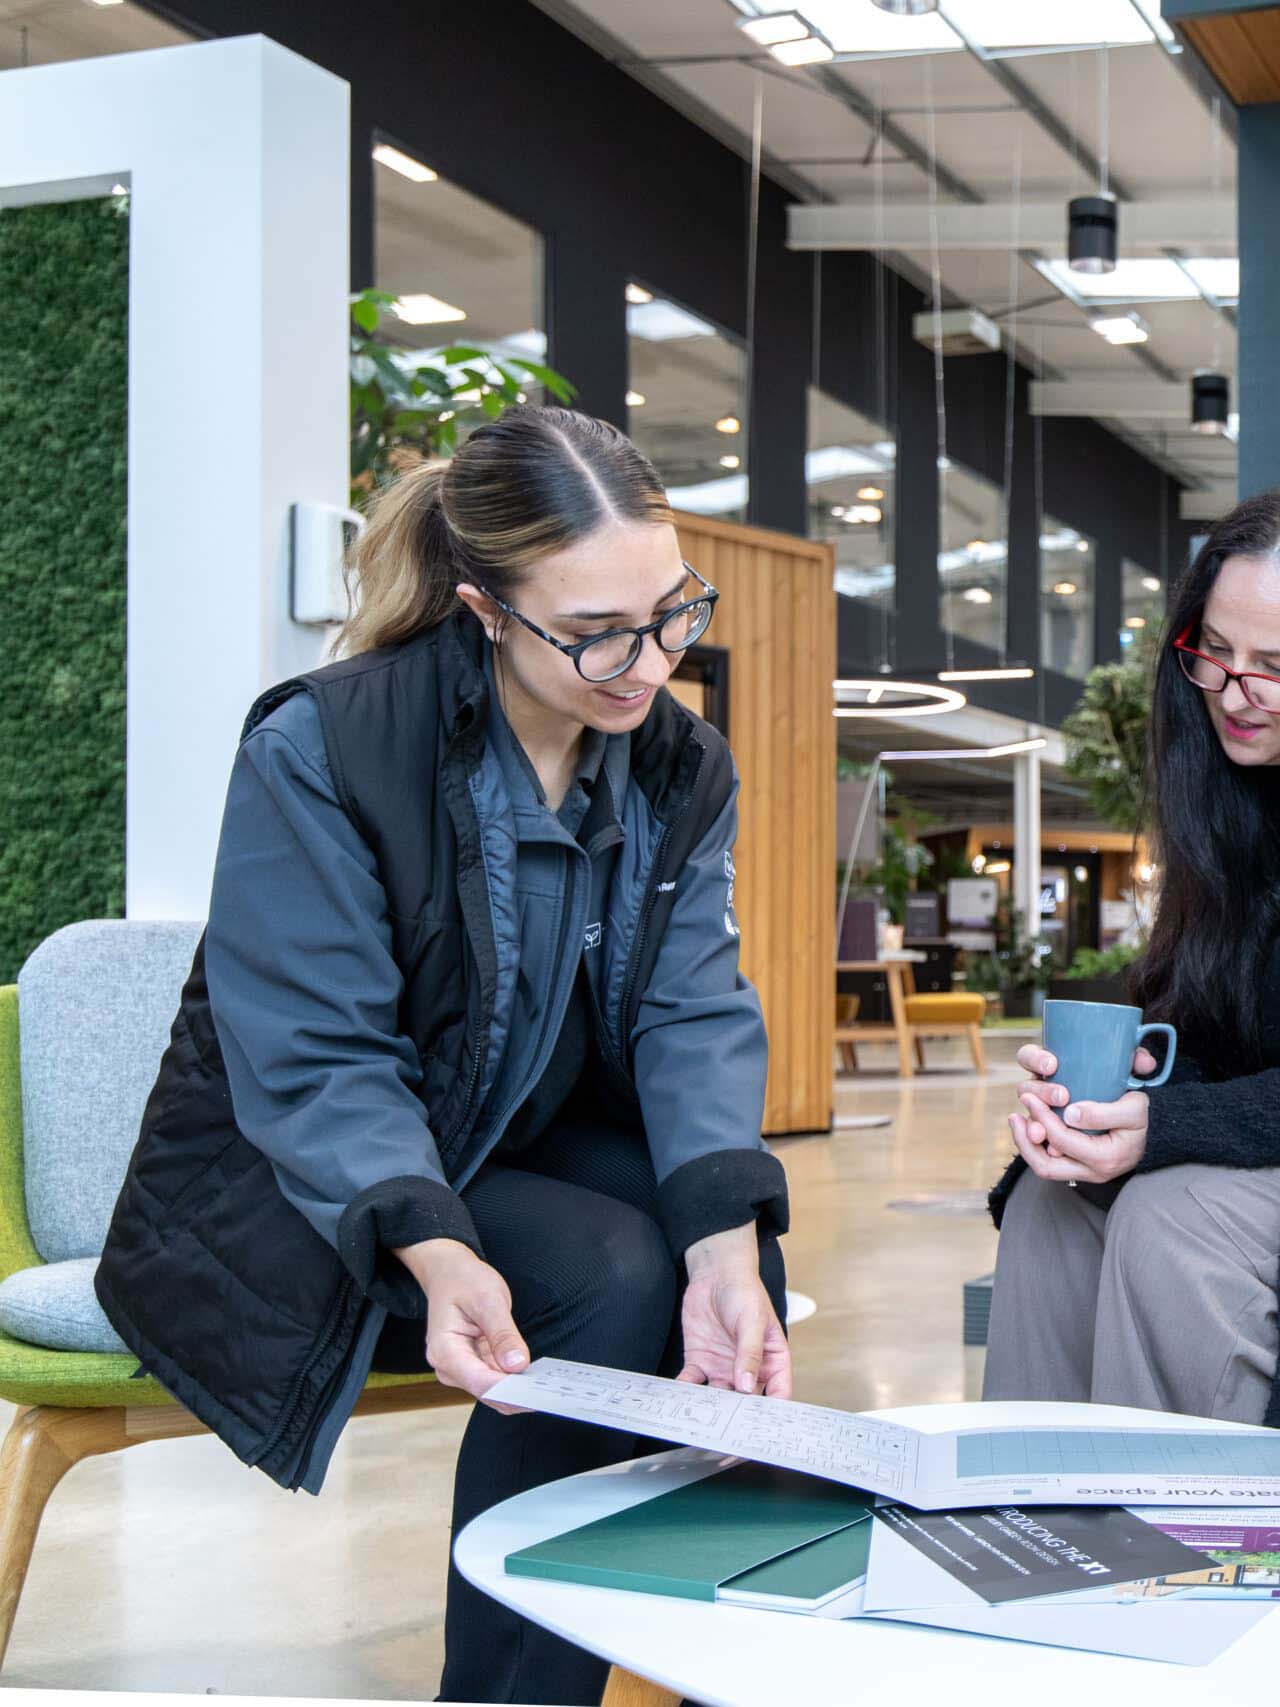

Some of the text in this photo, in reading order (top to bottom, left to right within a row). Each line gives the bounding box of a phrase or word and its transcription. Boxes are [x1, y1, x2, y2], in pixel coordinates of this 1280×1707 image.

[1076, 1487, 1157, 1496] space
[1162, 1488, 1223, 1496] your
[1057, 1546, 1091, 1562] THE
[1077, 1561, 1111, 1575] X1
